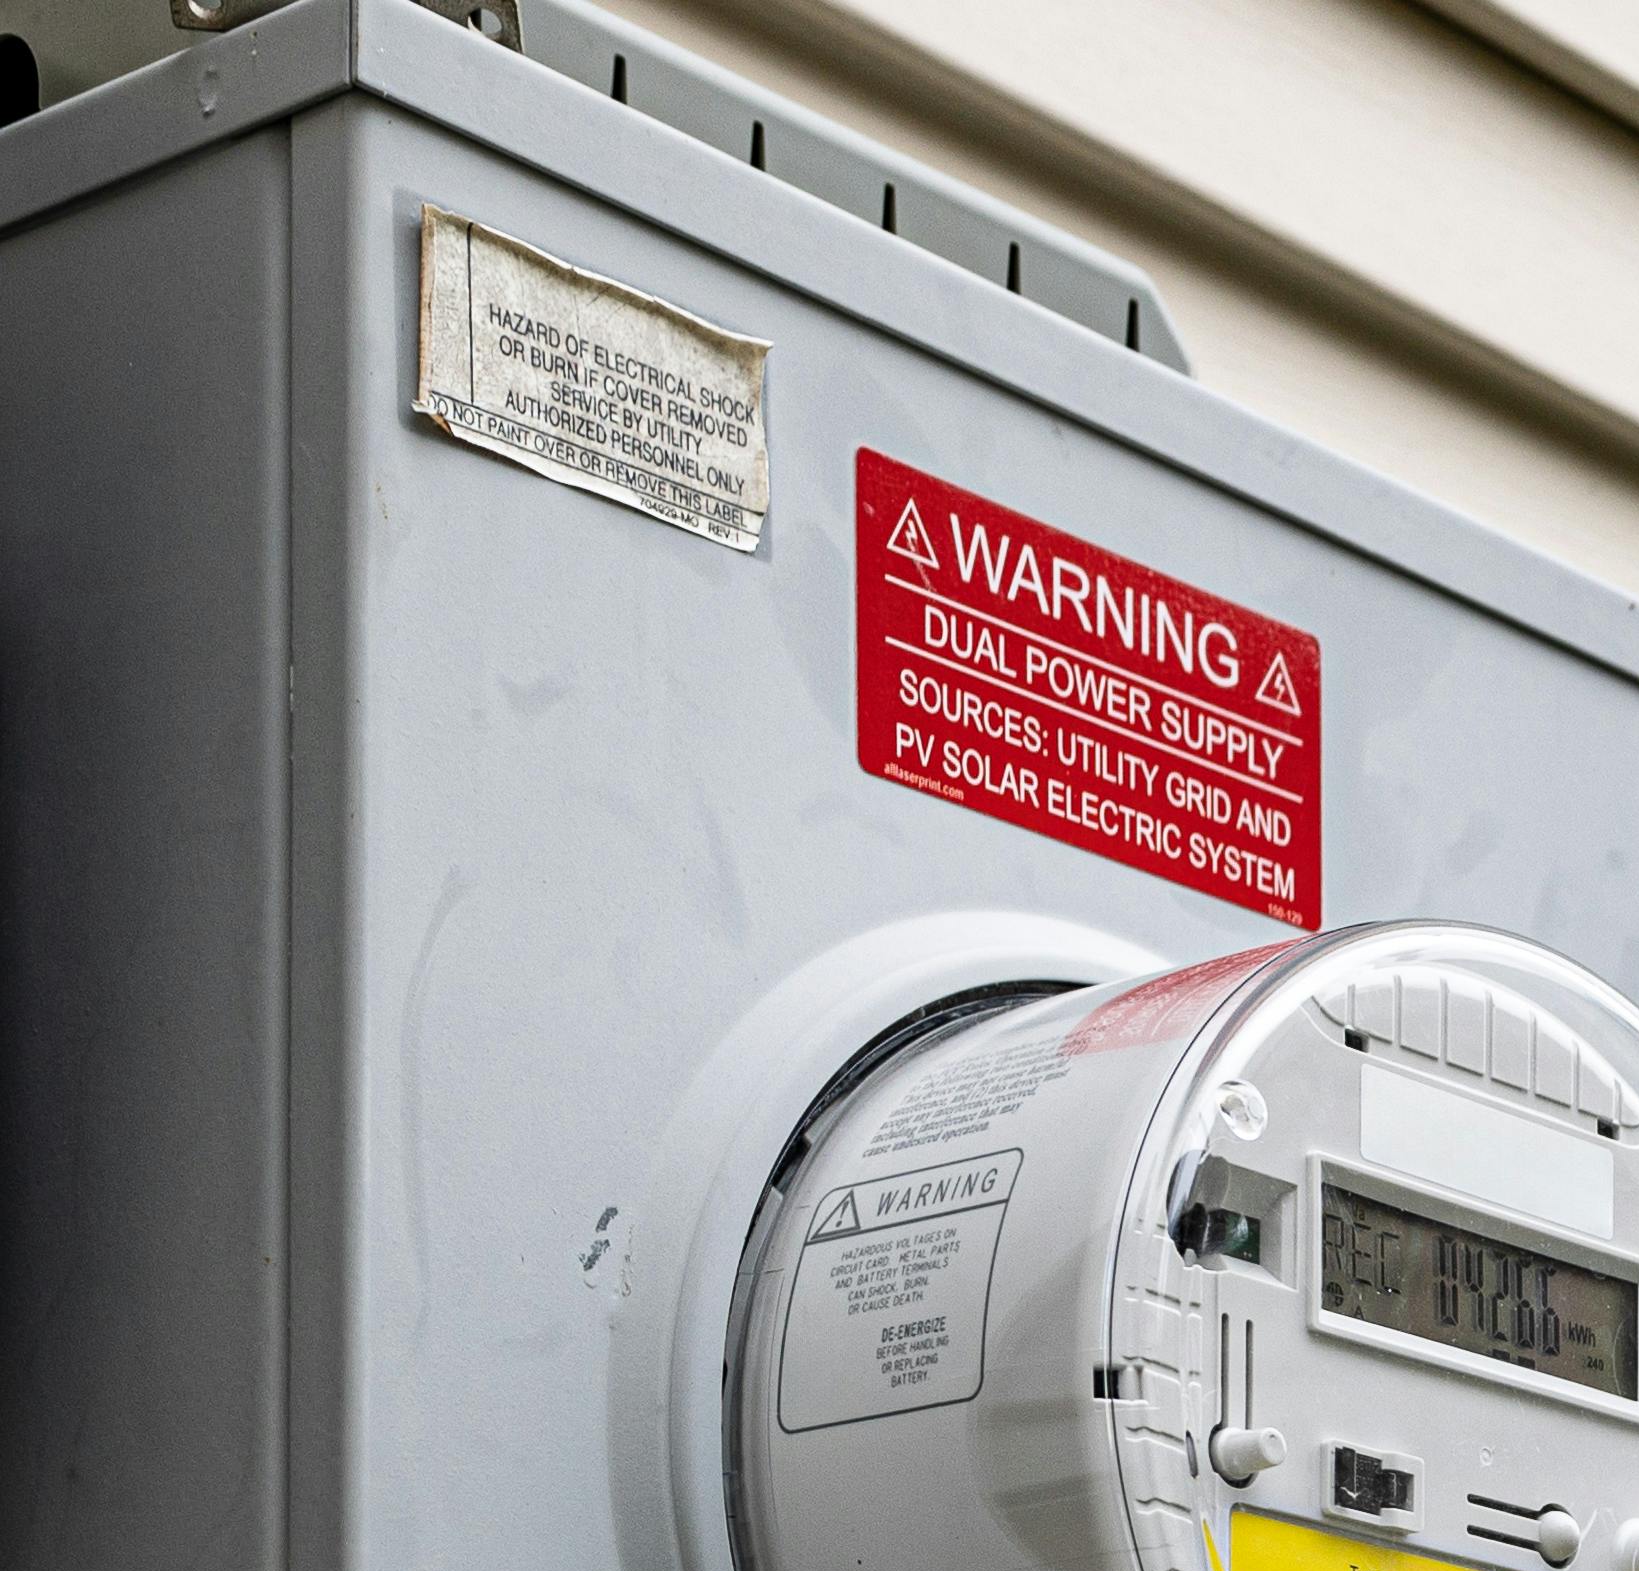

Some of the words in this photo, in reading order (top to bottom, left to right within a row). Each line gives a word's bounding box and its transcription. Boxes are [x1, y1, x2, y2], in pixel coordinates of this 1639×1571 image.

[489, 303, 560, 349] HAZARD
[566, 334, 589, 358] OF
[594, 344, 696, 404] ELECTRICAL
[700, 387, 755, 426] SHOCK
[500, 335, 525, 362] OR
[531, 346, 579, 384] BURN
[584, 367, 598, 388] IF
[604, 375, 662, 415] COVER
[668, 400, 747, 447] REMOVED
[505, 390, 607, 444] AUTHORIZED
[611, 431, 704, 482] PERSONNEL
[707, 466, 745, 497] ONLY
[551, 381, 618, 425] SERVICE
[623, 409, 643, 433] BY
[647, 417, 702, 455] UTILITY
[453, 404, 483, 429] NOT
[488, 417, 530, 446] PAINT
[534, 435, 576, 464] OVER
[579, 451, 601, 473] OR
[606, 461, 667, 498] REMOVE
[670, 484, 702, 511] THIS
[706, 500, 748, 528] LABEL
[949, 512, 1239, 689] WARNING
[923, 604, 1018, 679] DUAL
[1026, 645, 1152, 733] POWER
[1161, 699, 1284, 780] SUPPLY
[900, 668, 1049, 758] SOURCES:
[1057, 730, 1159, 797] UTILITY
[1165, 770, 1232, 826] GRID
[1237, 801, 1292, 849] AND
[895, 723, 935, 768] PV
[942, 740, 1040, 809] SOLAR
[1047, 780, 1182, 860] ELECTRIC
[1188, 832, 1295, 903] SYSTEM
[876, 1168, 998, 1217] WARNING
[830, 1261, 863, 1278] CIRCUIT
[930, 1240, 961, 1256] PARTS
[835, 1276, 853, 1290] AND
[857, 1267, 899, 1287] BATTERY
[841, 1240, 893, 1262] HAZARDOUS
[944, 1228, 957, 1240] ON
[847, 1289, 866, 1302] CAN
[847, 1303, 860, 1316] OR
[861, 1297, 890, 1314] CAUSE
[1322, 1213, 1401, 1296] REC
[1437, 1233, 1561, 1358] 04266
[1568, 1320, 1597, 1348] kWh
[876, 1341, 908, 1360] BEFORE
[909, 1334, 950, 1352] HANDLING
[881, 1316, 947, 1344] DE-ENERGIZE
[881, 1361, 893, 1375] OR
[894, 1352, 939, 1371] REPLACING
